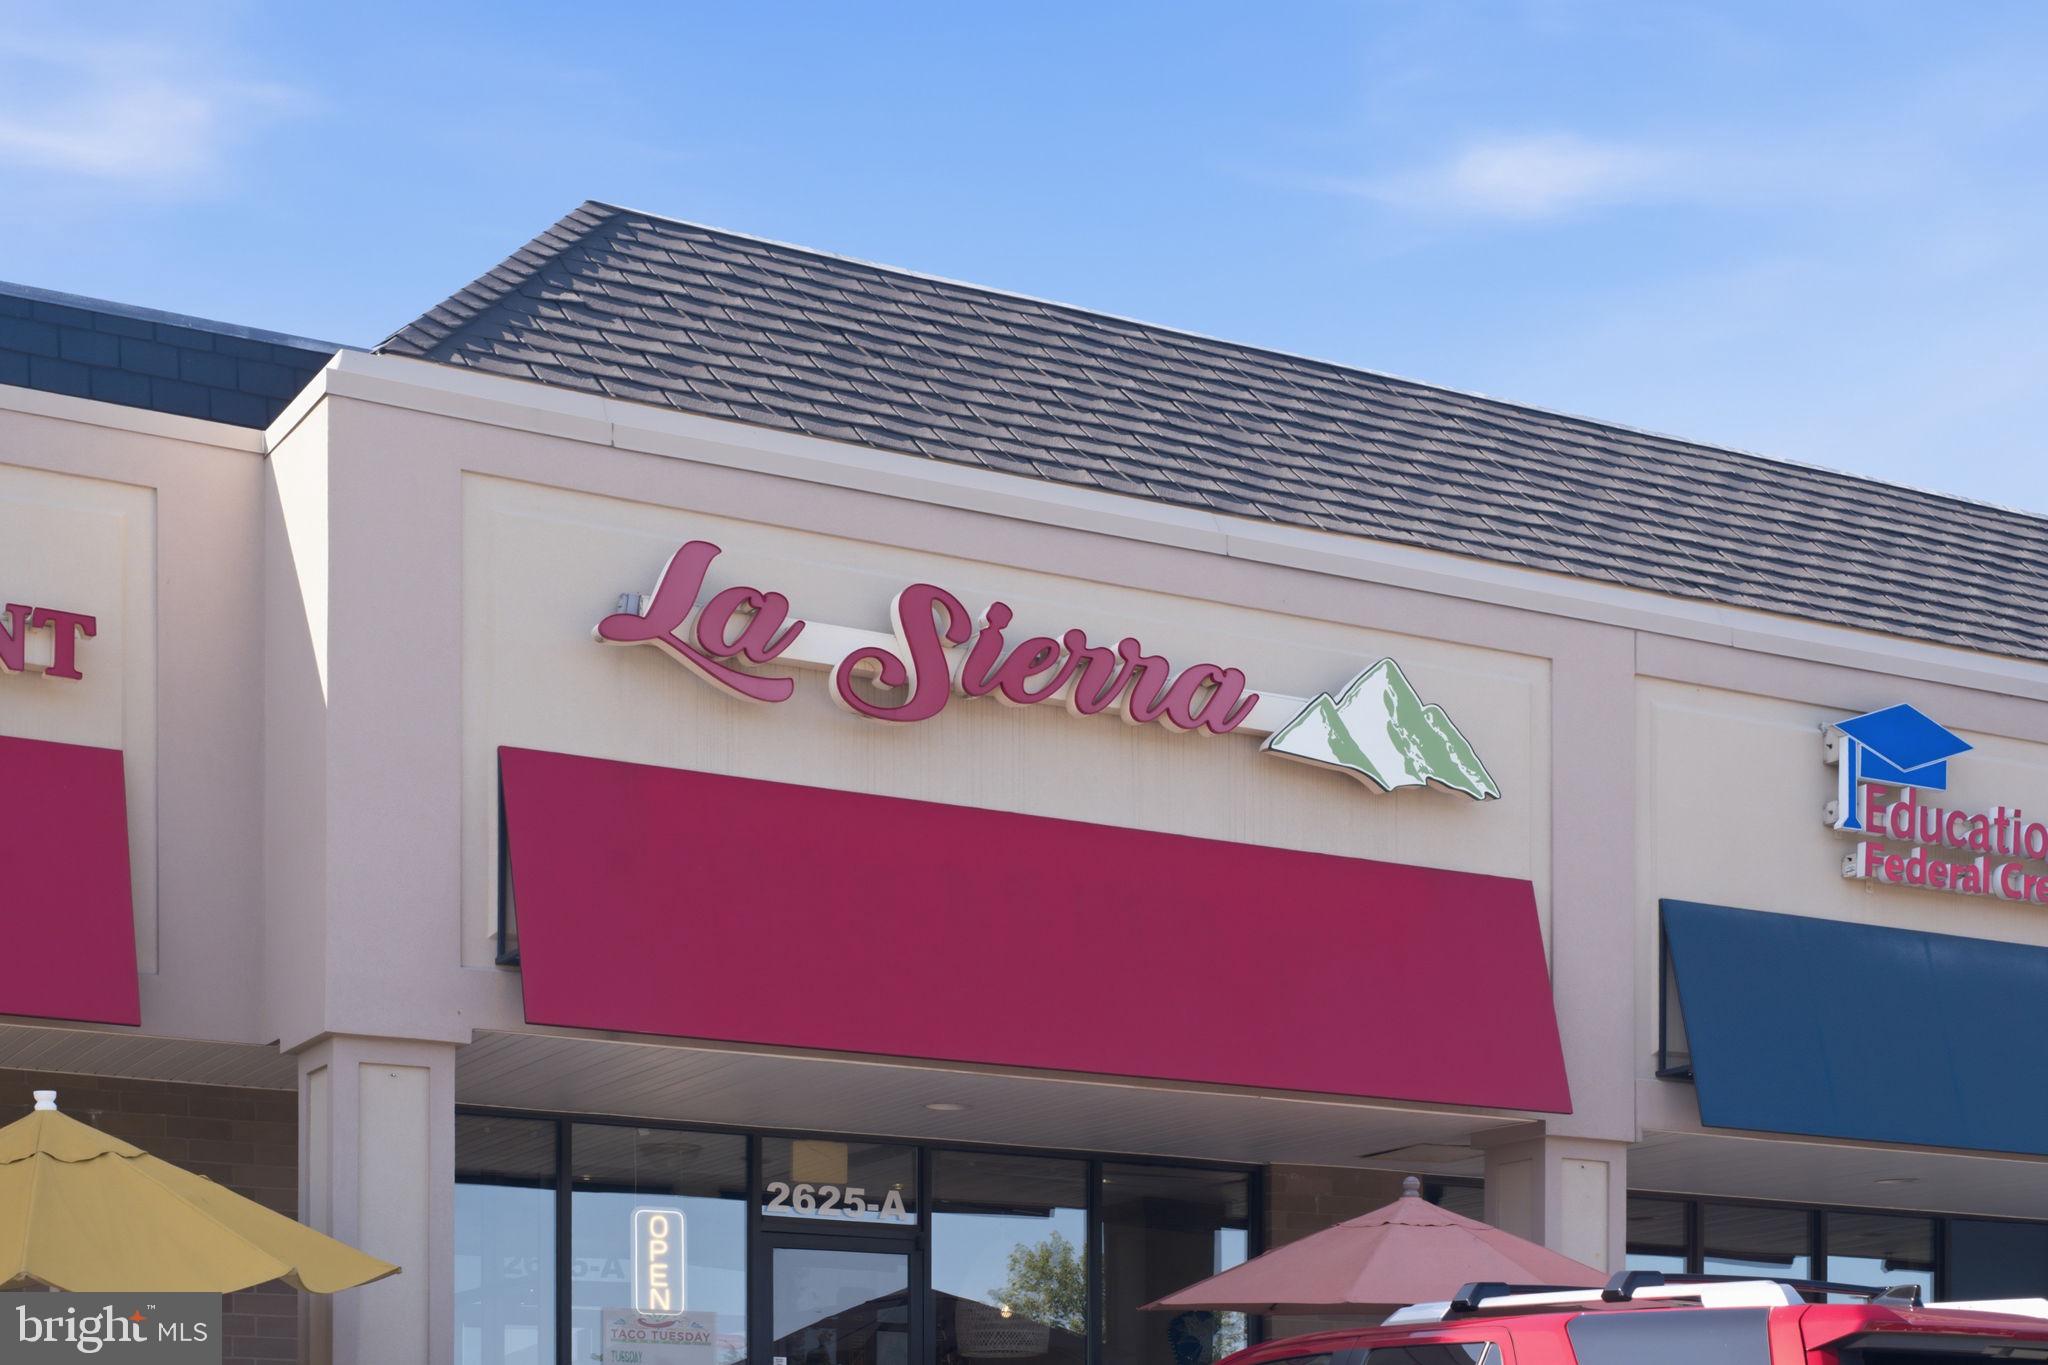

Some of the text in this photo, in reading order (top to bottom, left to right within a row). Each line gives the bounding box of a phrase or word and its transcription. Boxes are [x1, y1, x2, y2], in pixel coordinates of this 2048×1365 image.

[595, 540, 1260, 735] La Sierra
[1858, 842, 1990, 895] Federal
[766, 1181, 908, 1222] 2625-A
[649, 1214, 672, 1312] OPEN
[611, 1328, 647, 1341] TACO
[652, 1330, 712, 1343] TUESDAY
[611, 1350, 643, 1364] TUESDAY
